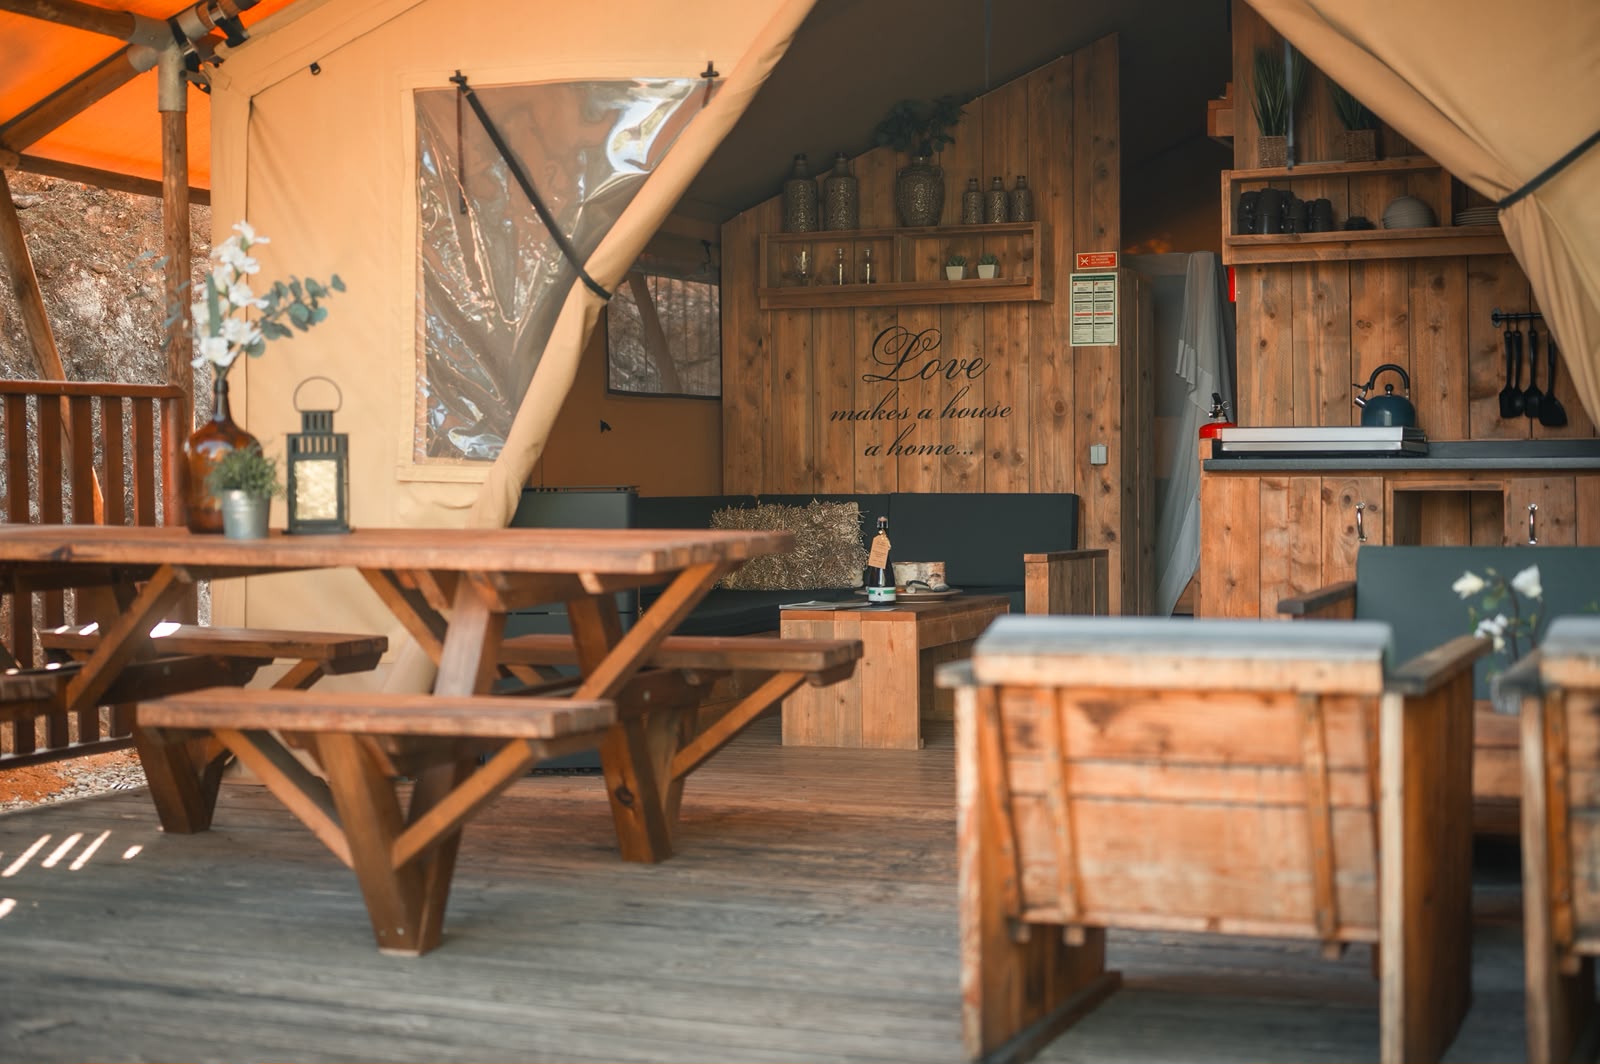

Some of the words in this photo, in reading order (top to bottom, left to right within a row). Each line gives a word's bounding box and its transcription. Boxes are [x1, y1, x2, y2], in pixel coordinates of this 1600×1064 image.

[862, 325, 991, 382] Love
[830, 387, 911, 422] makes
[917, 408, 933, 420] a
[940, 386, 1013, 419] house
[864, 444, 881, 457] a
